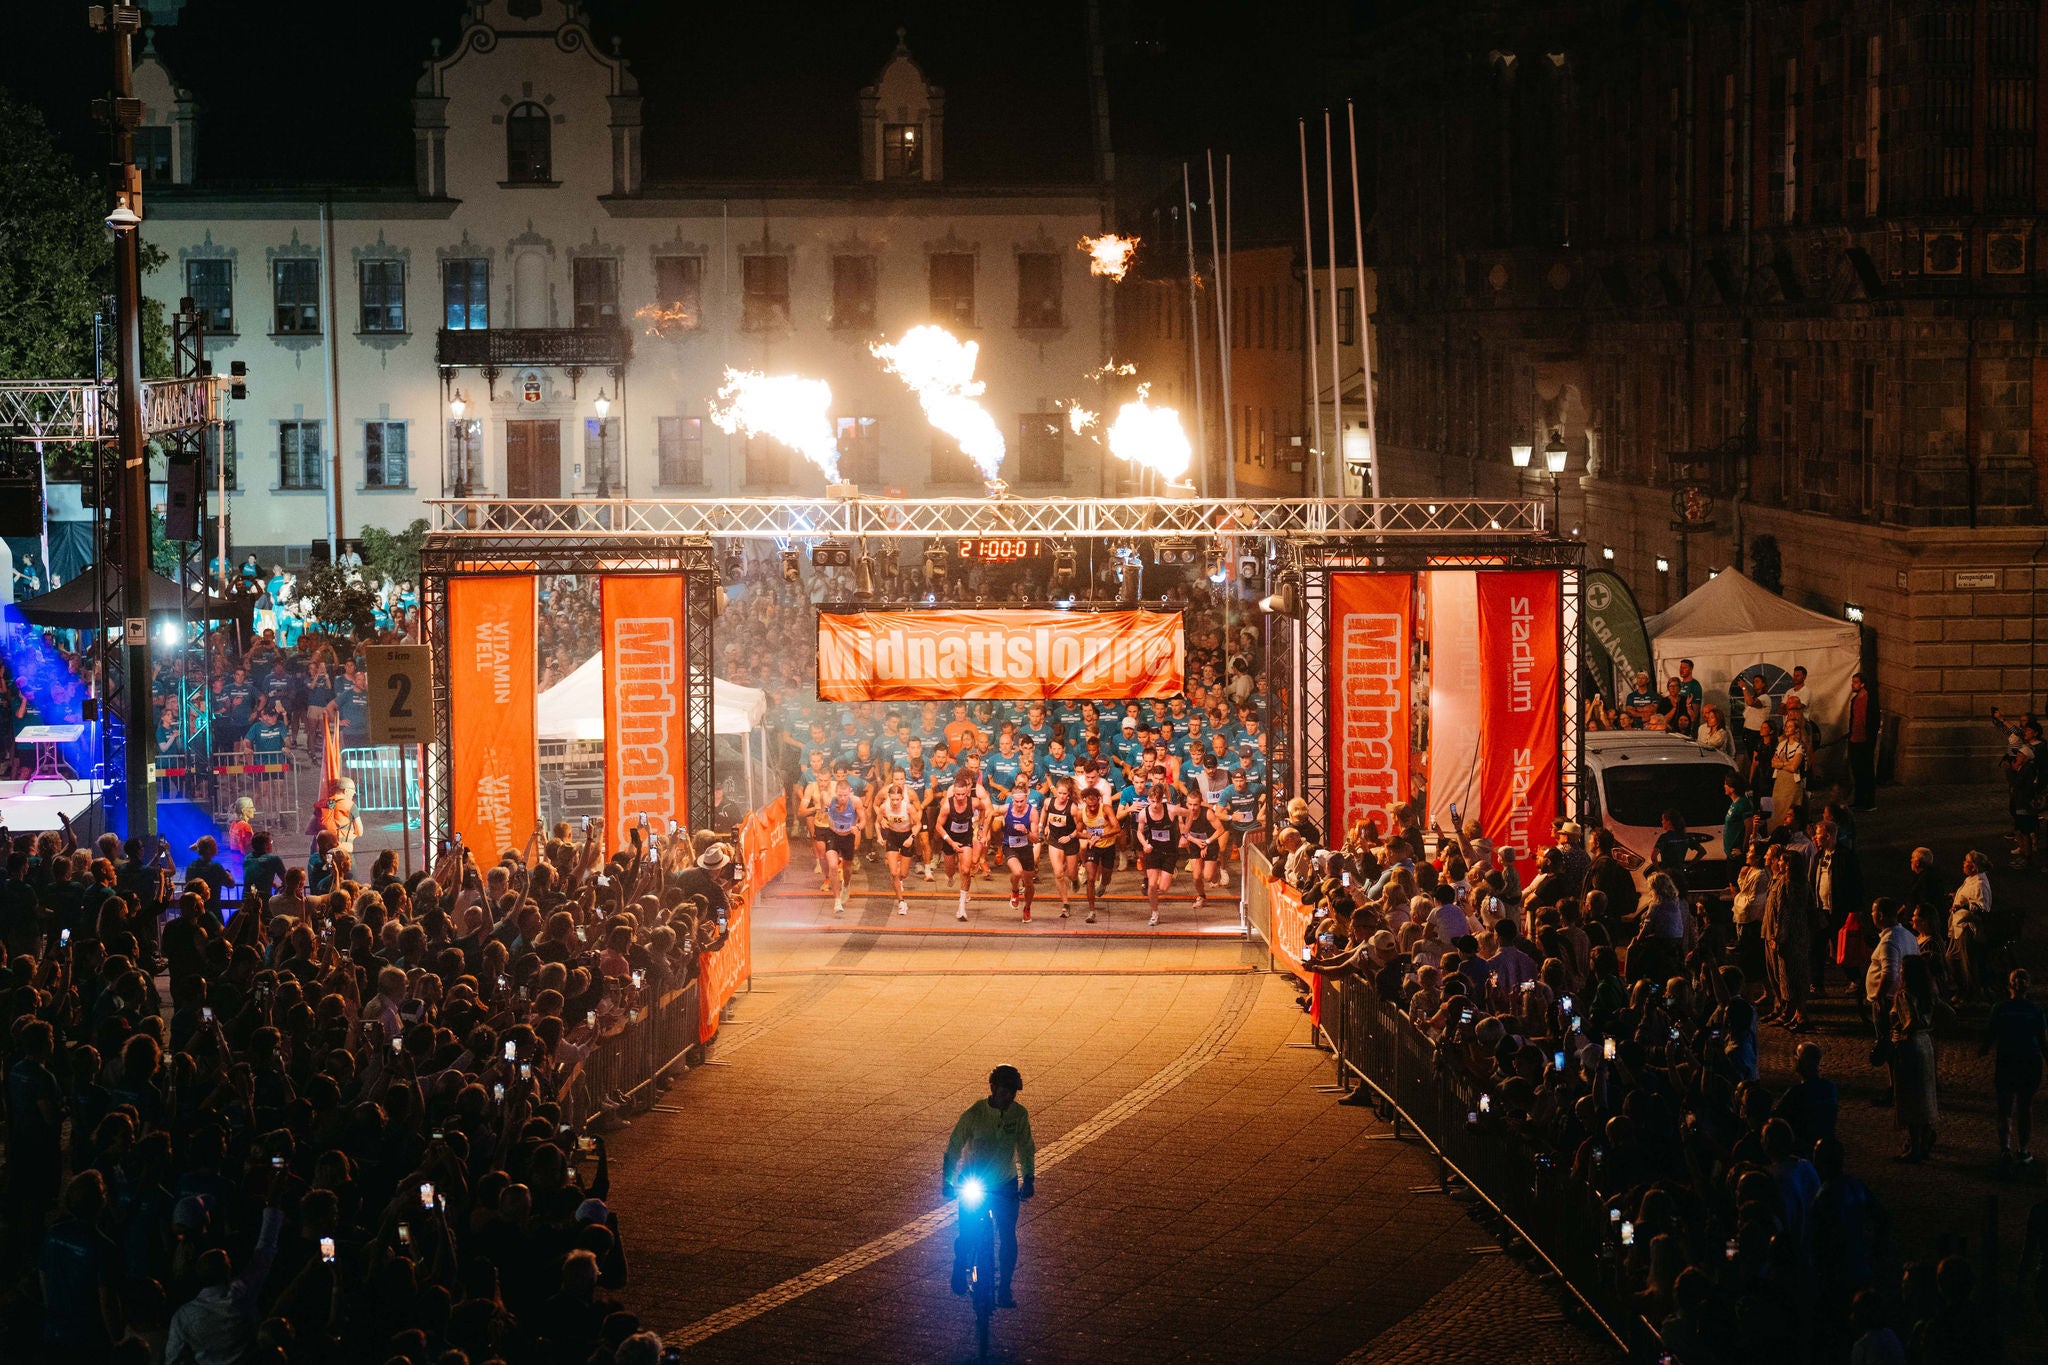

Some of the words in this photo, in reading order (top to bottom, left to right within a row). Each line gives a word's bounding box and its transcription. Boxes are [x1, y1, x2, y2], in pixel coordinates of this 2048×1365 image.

[960, 541, 1039, 557] 21:00:01
[475, 622, 492, 672] WELL
[493, 621, 511, 704] VITAMIN
[1510, 596, 1535, 712] stadium
[388, 673, 412, 717] 2
[477, 775, 494, 825] WELL
[493, 774, 512, 856] VITAMIN
[1510, 748, 1535, 861] stadium
